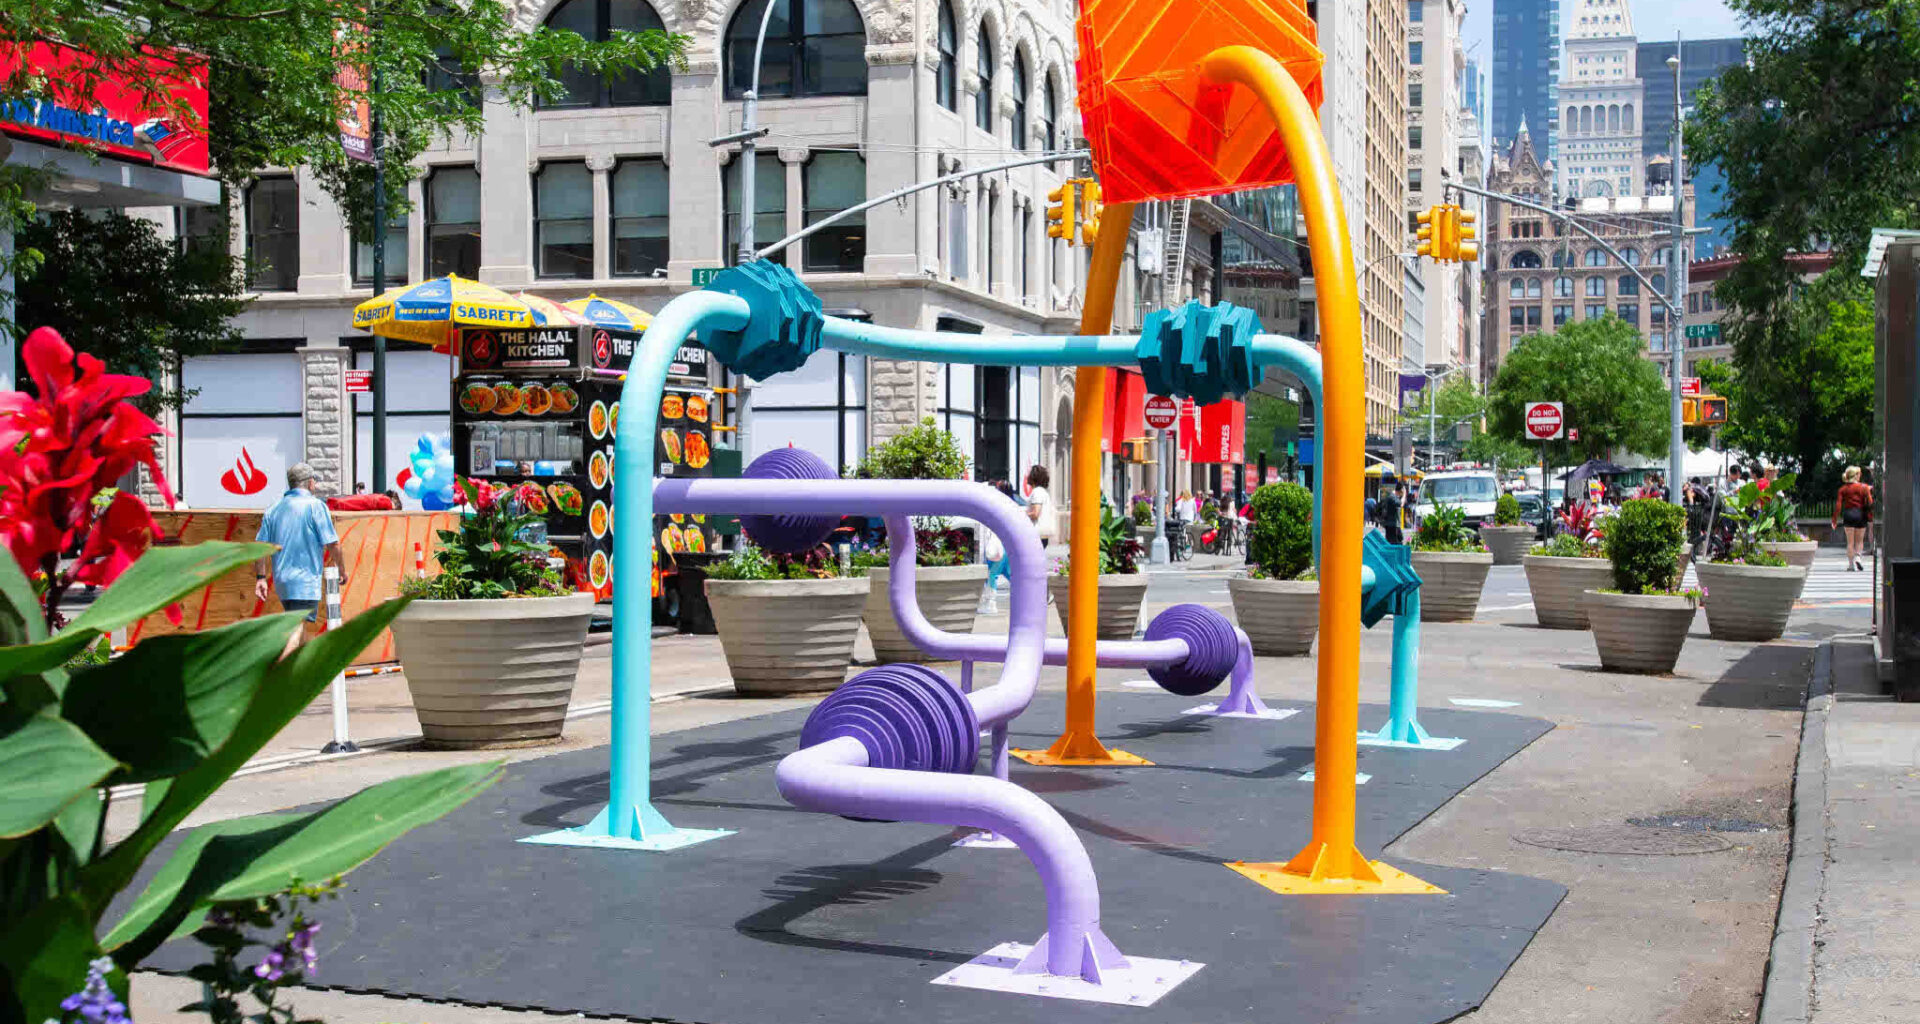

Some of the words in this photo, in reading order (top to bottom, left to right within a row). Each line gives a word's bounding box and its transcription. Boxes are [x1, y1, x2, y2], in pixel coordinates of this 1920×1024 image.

[699, 271, 705, 284] E
[355, 305, 392, 323] SABRETT
[457, 305, 527, 322] SABRETT
[500, 332, 525, 343] THE
[529, 331, 573, 343] HALAL
[1697, 326, 1706, 336] 14
[508, 344, 565, 356] KITCHEN
[612, 338, 632, 356] THE
[674, 346, 706, 364] TCHEN
[1221, 424, 1231, 461] STAPLES
